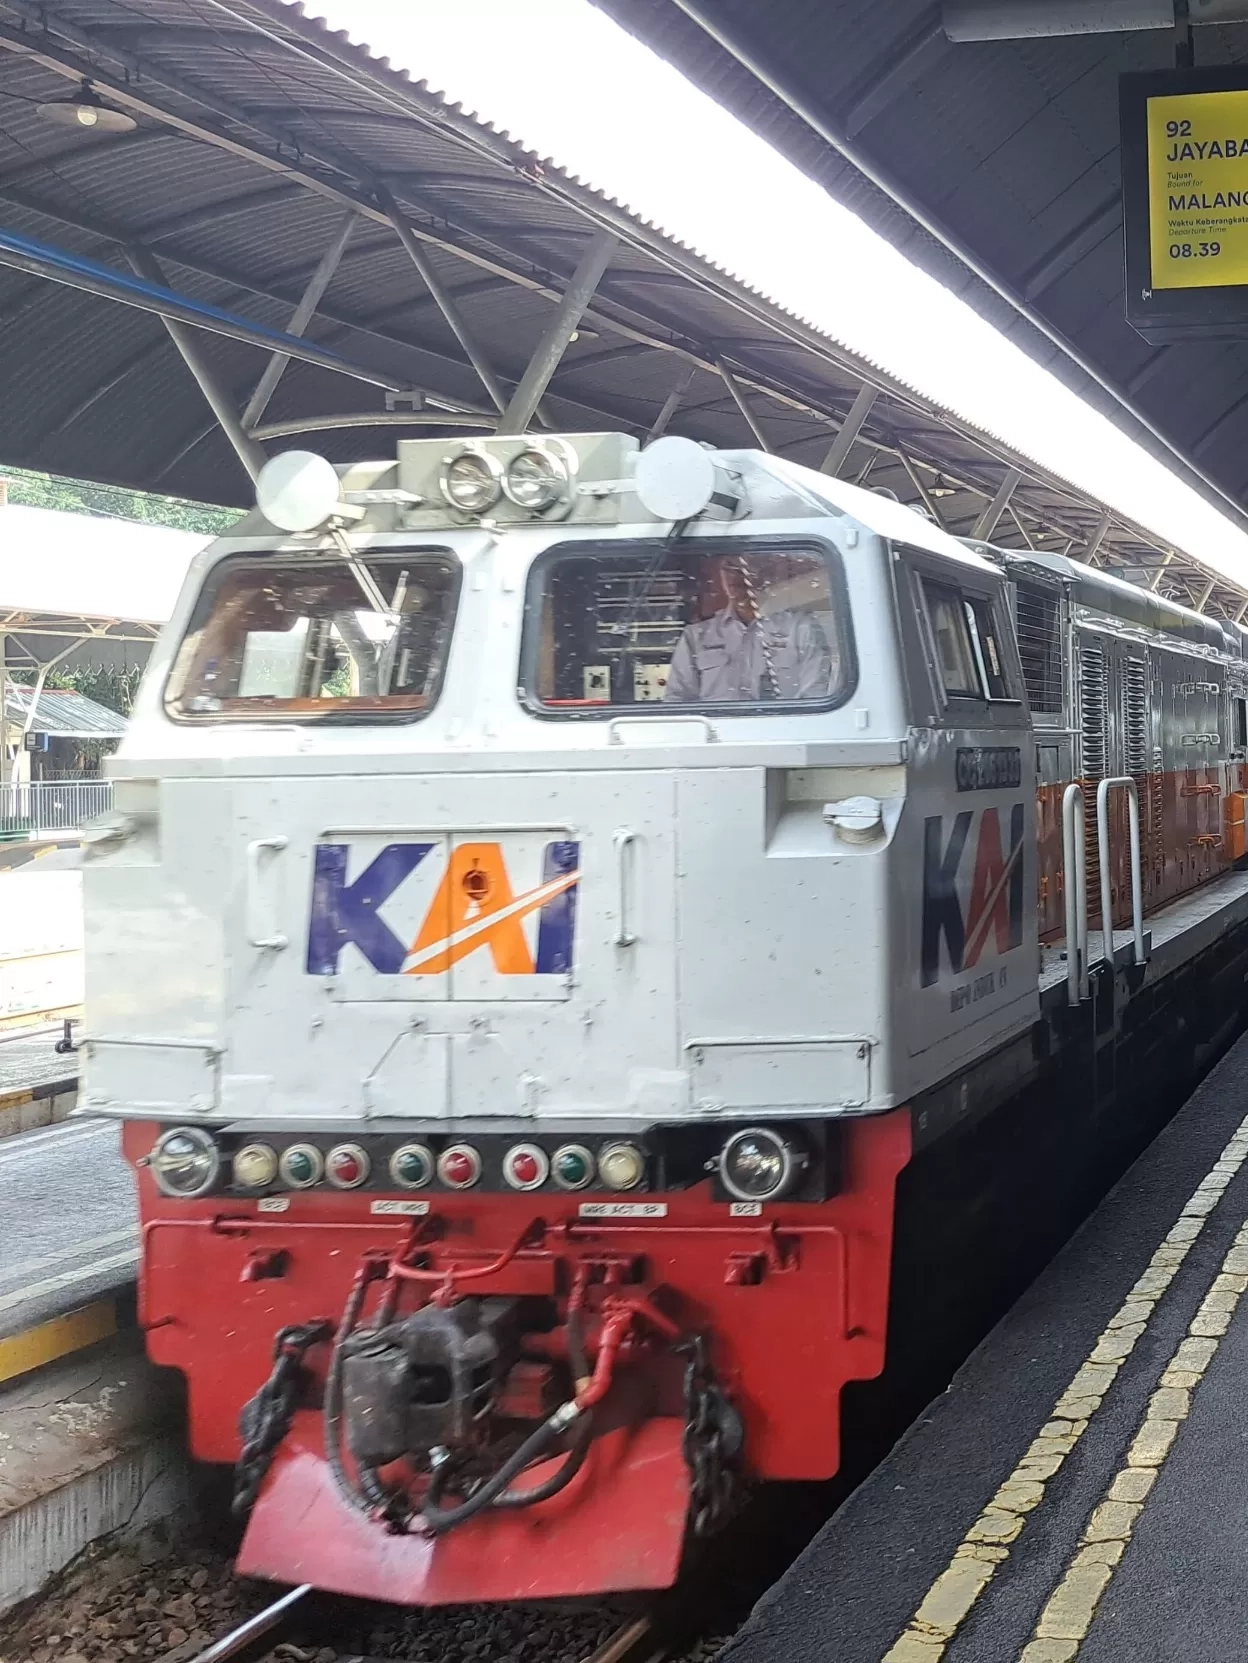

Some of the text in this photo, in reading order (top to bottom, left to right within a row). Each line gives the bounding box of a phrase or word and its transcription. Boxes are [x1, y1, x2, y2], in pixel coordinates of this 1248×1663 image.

[1166, 120, 1192, 138] 92
[1167, 171, 1193, 180] Tujuan
[1167, 179, 1203, 188] Bound for
[1168, 219, 1194, 227] Waktu
[1168, 228, 1207, 236] Departure
[1169, 242, 1221, 259] 08.39
[920, 803, 1025, 989] KAI
[306, 841, 582, 974] KAI
